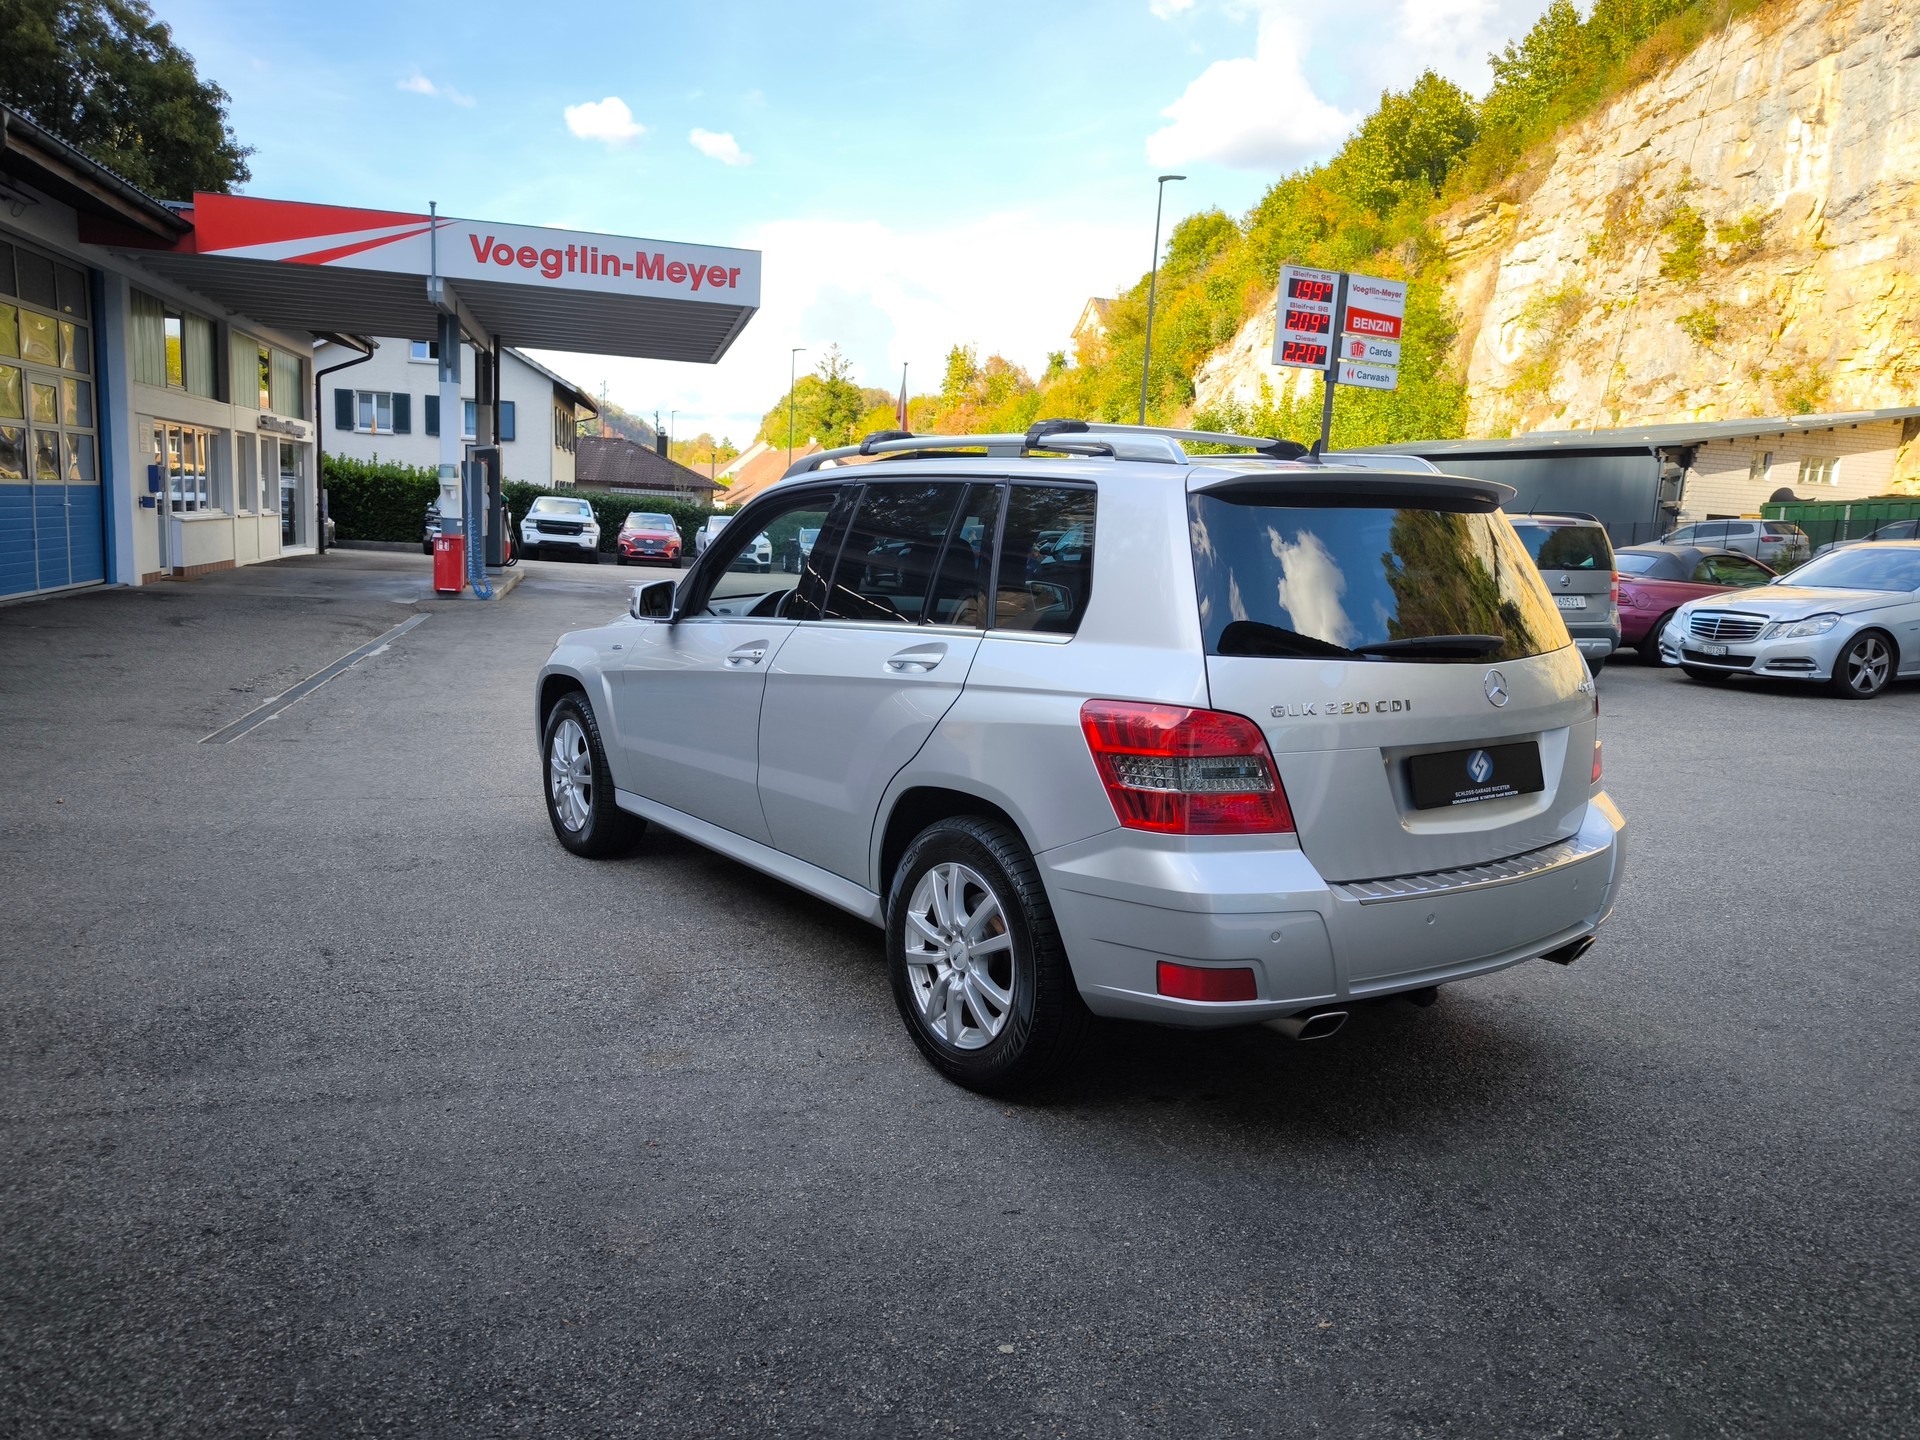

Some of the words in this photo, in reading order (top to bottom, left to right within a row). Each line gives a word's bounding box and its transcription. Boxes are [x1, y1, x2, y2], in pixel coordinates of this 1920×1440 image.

[469, 234, 741, 291] Voegtlin-Meyer
[1292, 270, 1319, 279] Bleifrei
[1352, 284, 1402, 299] Voegtlin-Meyer
[1289, 301, 1316, 311] Bleifrei
[1352, 316, 1394, 333] BENZIN
[1295, 334, 1318, 343] Diesel
[1369, 346, 1393, 358] Cards
[1356, 370, 1390, 382] Carwash
[1270, 702, 1317, 718] GLK
[1325, 701, 1370, 715] 220
[1375, 699, 1411, 713] CDI
